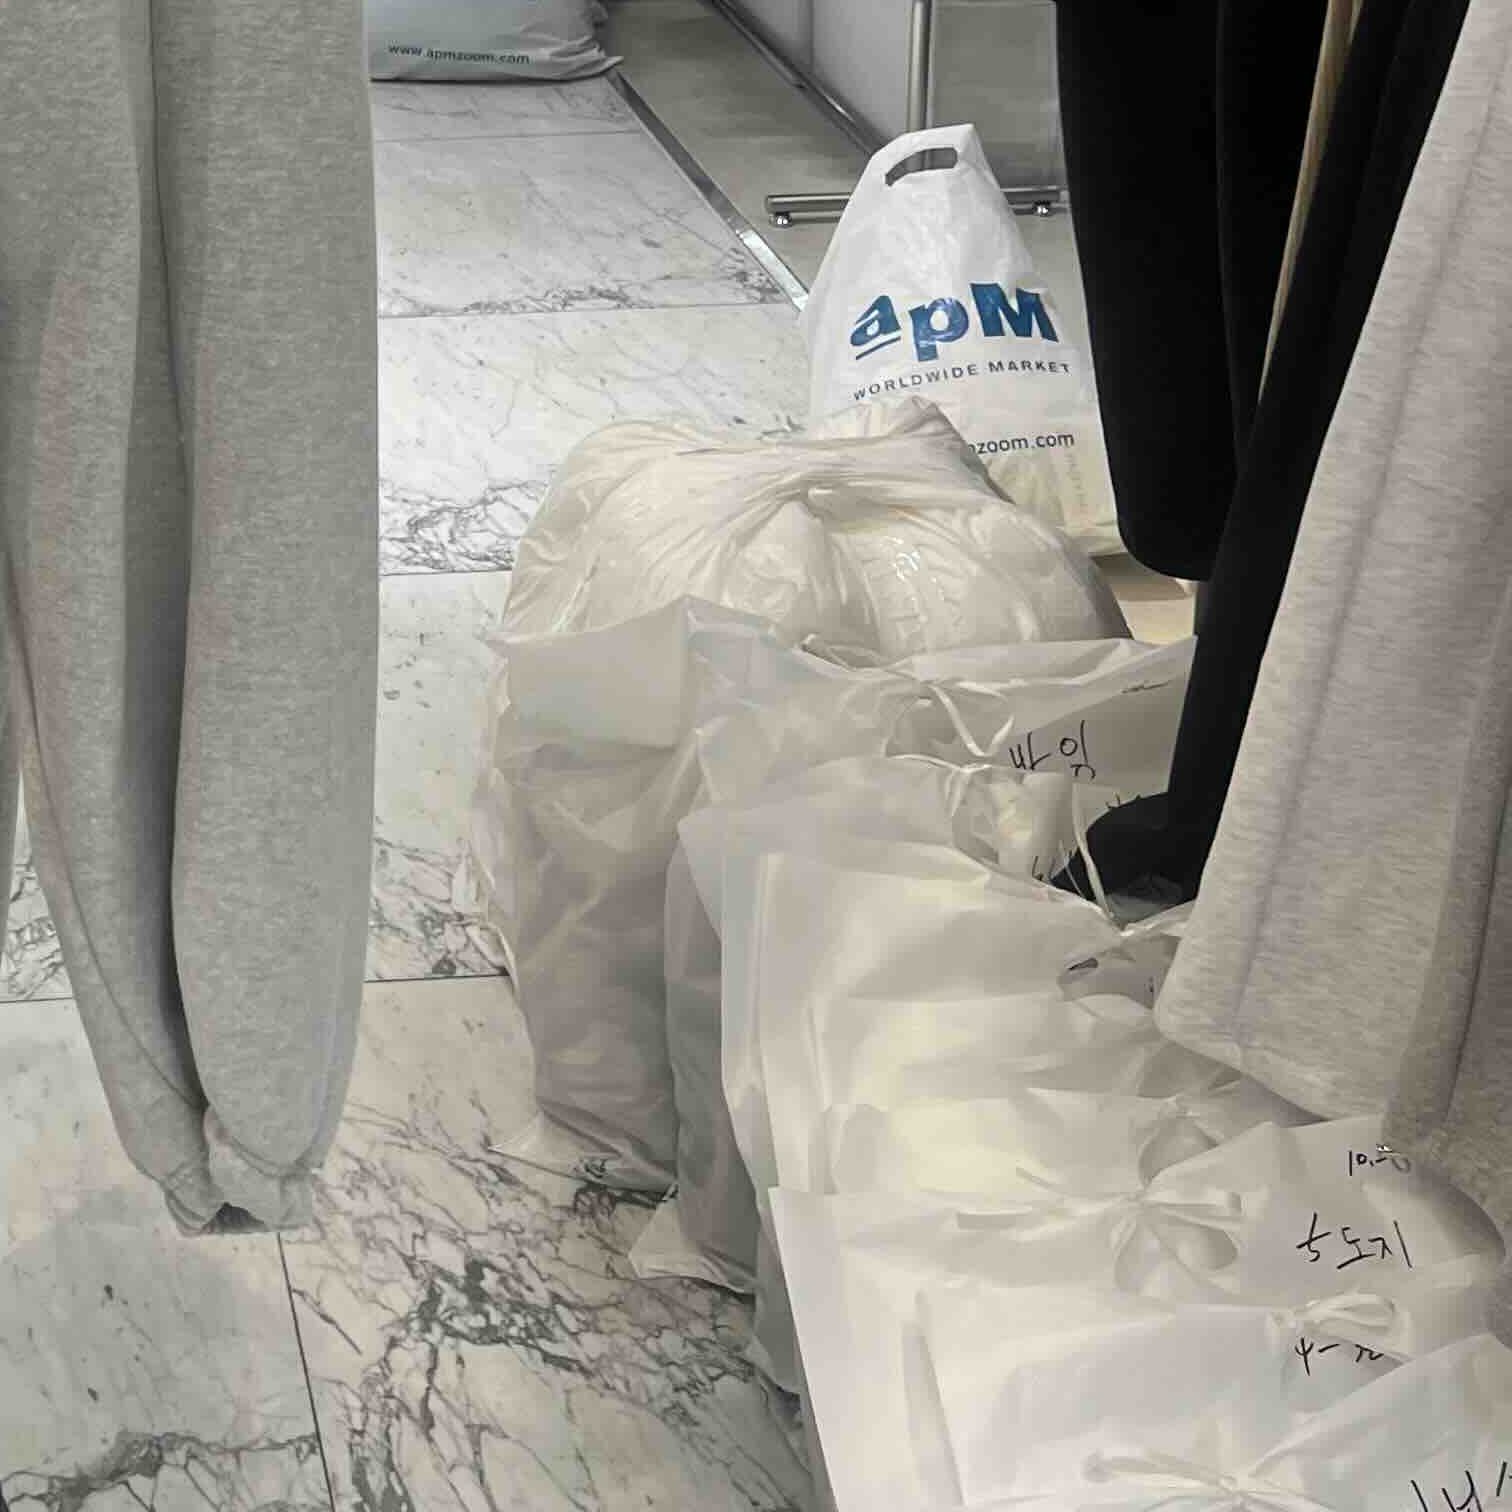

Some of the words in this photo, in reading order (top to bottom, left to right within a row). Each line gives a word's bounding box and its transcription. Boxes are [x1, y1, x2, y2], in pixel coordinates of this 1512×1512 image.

[387, 44, 531, 65] www.apmzoom.com
[849, 282, 1060, 362] apM
[852, 363, 979, 401] WORLDWIDE
[988, 360, 1072, 374] MARKET
